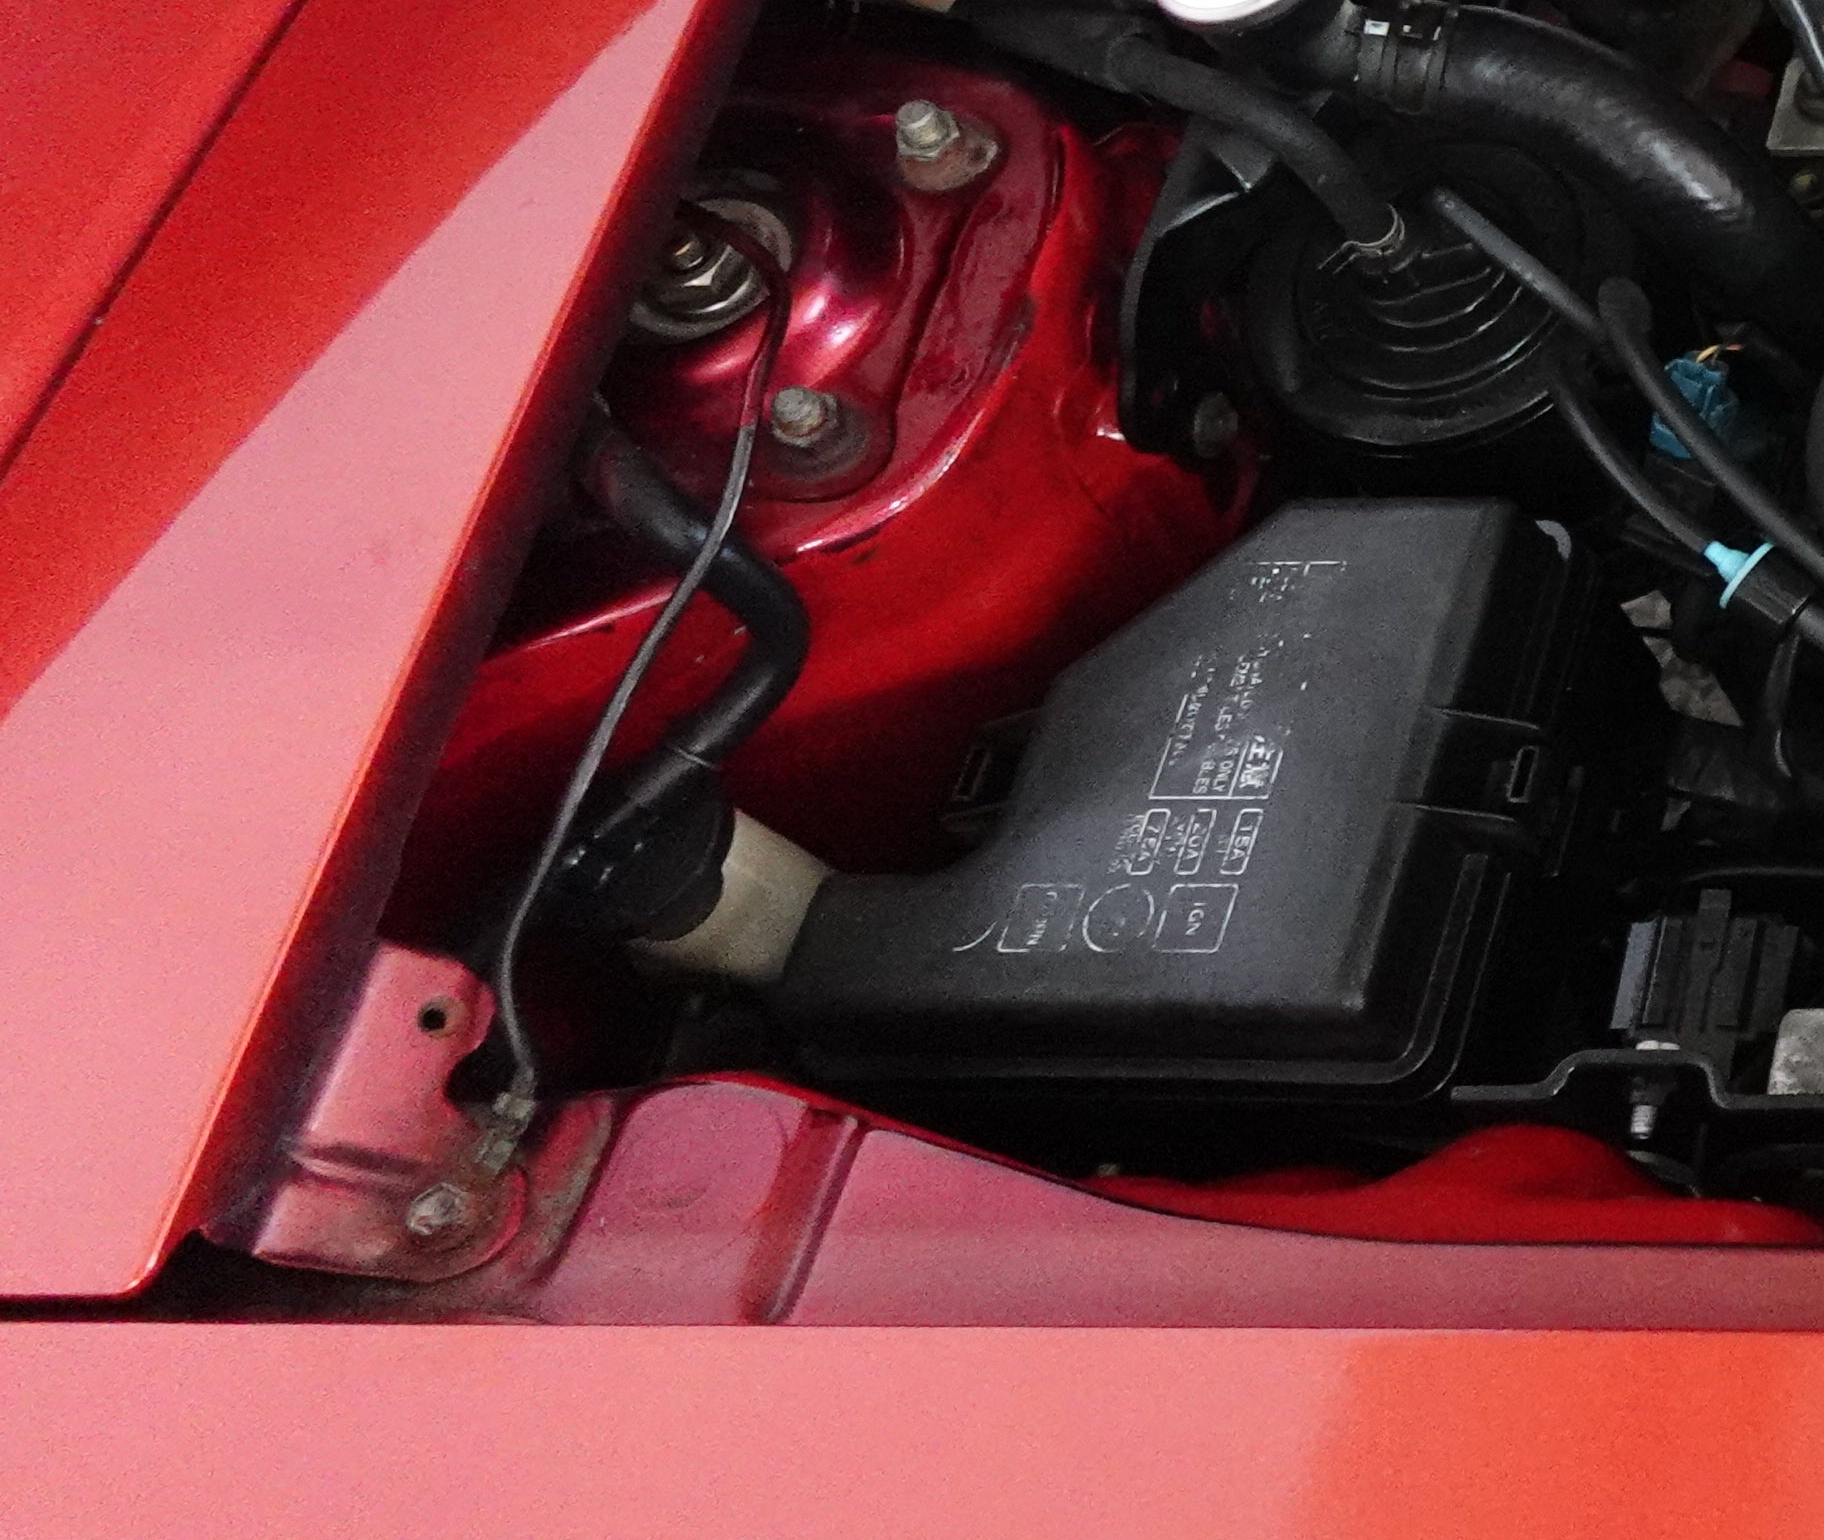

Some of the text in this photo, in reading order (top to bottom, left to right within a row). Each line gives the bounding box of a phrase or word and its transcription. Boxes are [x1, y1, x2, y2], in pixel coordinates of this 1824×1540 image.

[1213, 761, 1235, 792] ONLY
[1186, 823, 1208, 860] 20A
[1231, 825, 1254, 861] 15A
[1184, 902, 1207, 936] IGN
